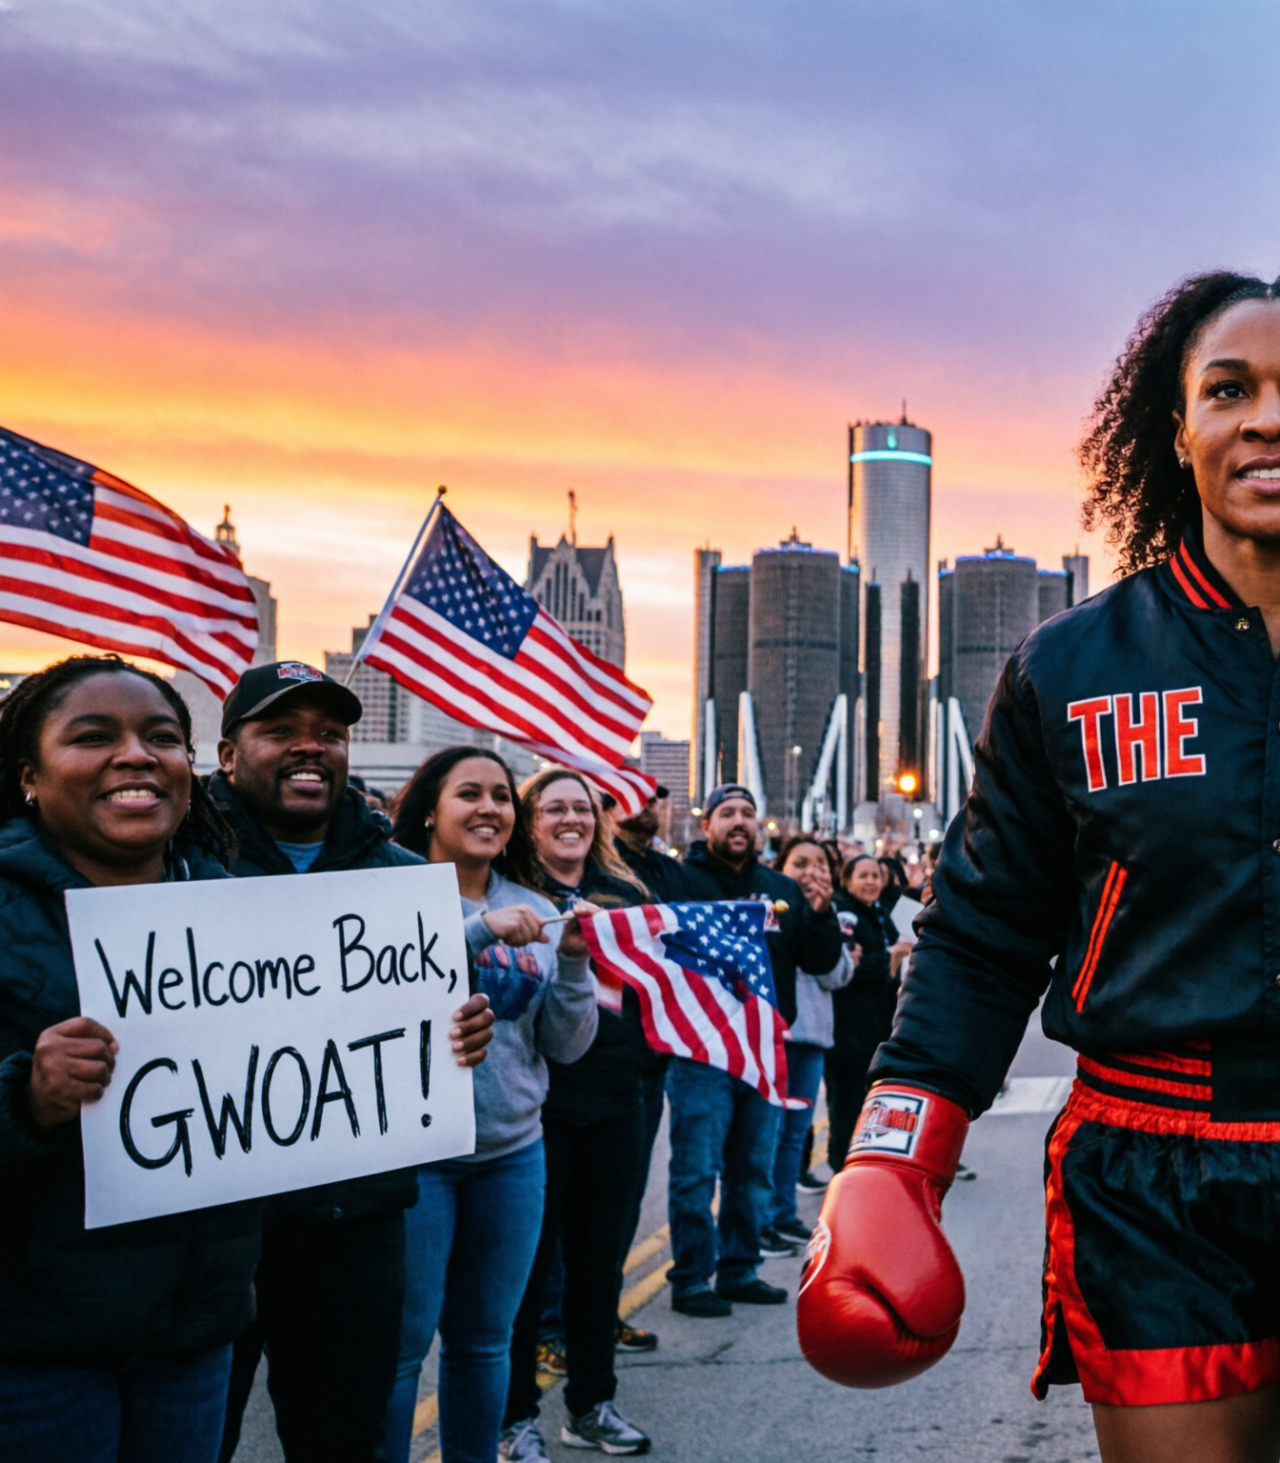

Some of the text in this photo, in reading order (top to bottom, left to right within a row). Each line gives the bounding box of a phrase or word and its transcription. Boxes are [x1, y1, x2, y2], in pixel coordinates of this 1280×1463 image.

[1067, 685, 1207, 793] THE
[94, 911, 458, 1019] Welcome Back,
[119, 1019, 433, 1178] GWOAT!
